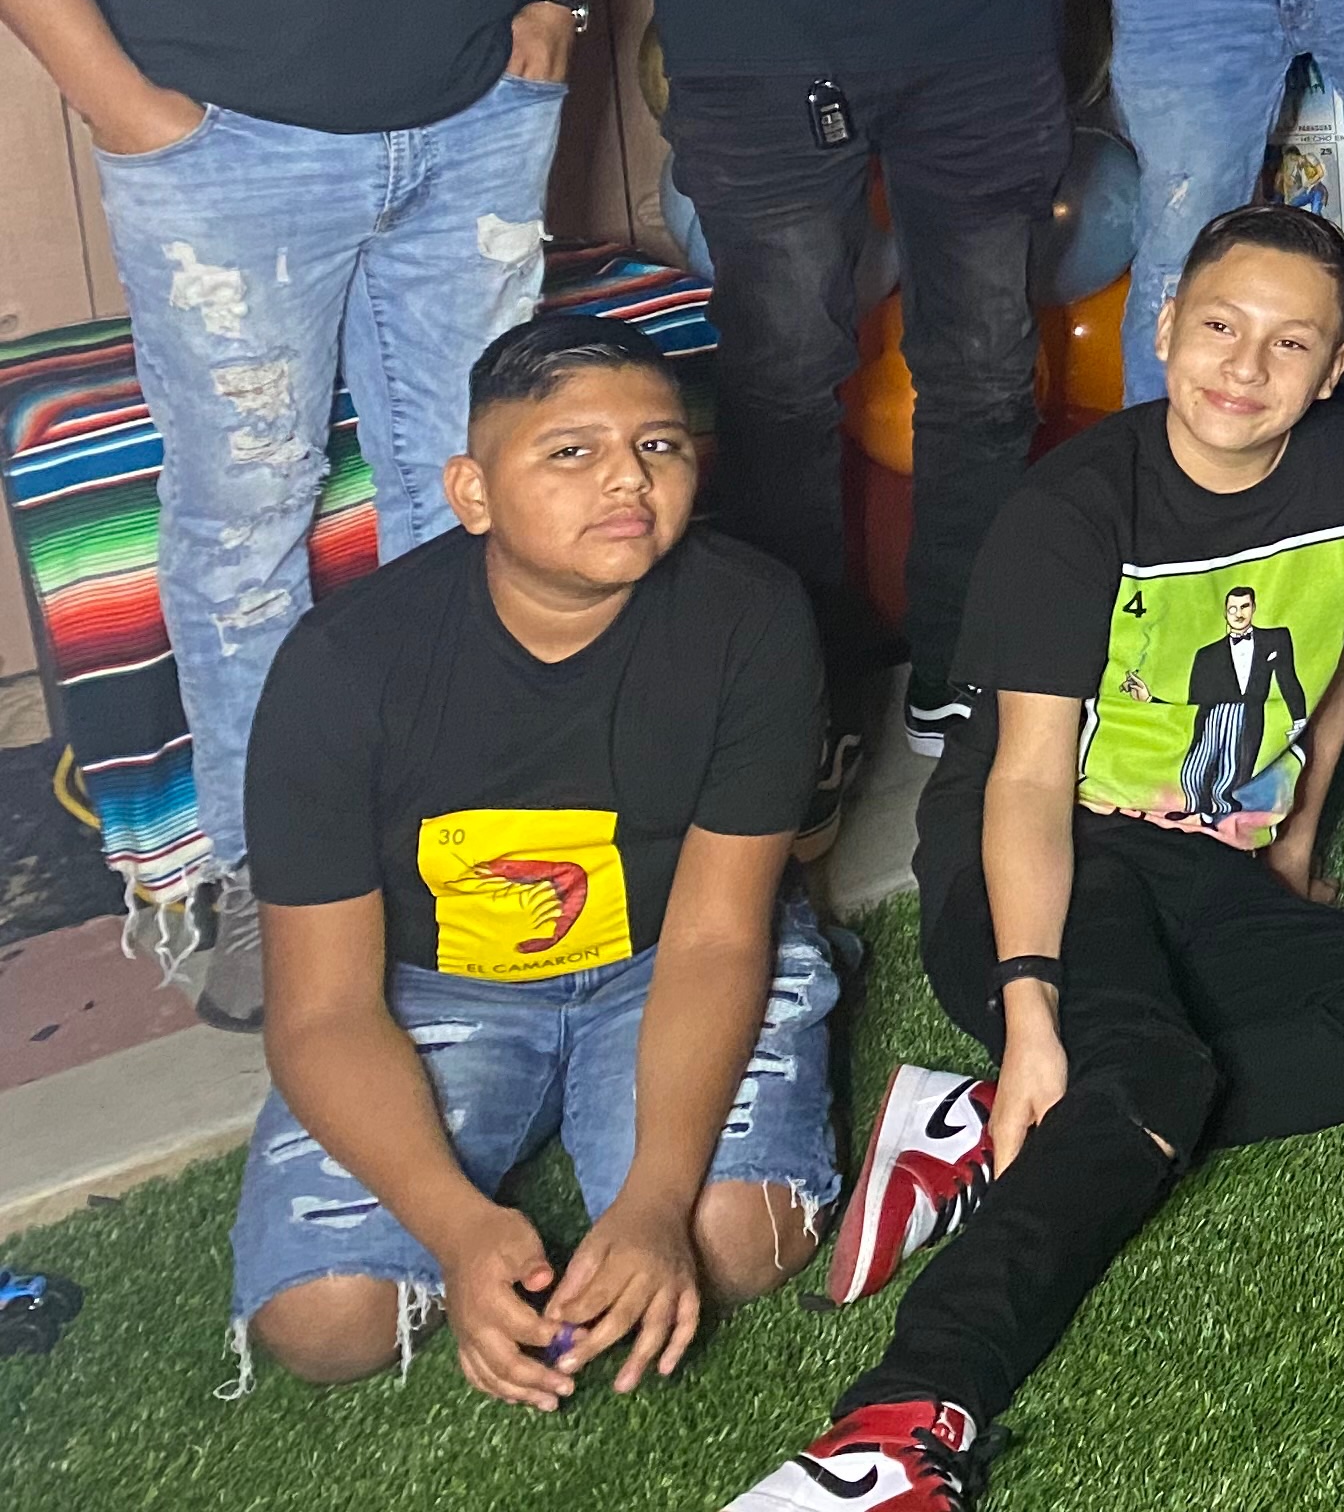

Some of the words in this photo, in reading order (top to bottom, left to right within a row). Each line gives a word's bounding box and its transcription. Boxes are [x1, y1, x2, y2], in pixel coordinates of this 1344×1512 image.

[1123, 590, 1147, 618] 4
[438, 828, 466, 846] 30
[467, 963, 484, 974] EL
[493, 947, 600, 974] CAMARON
